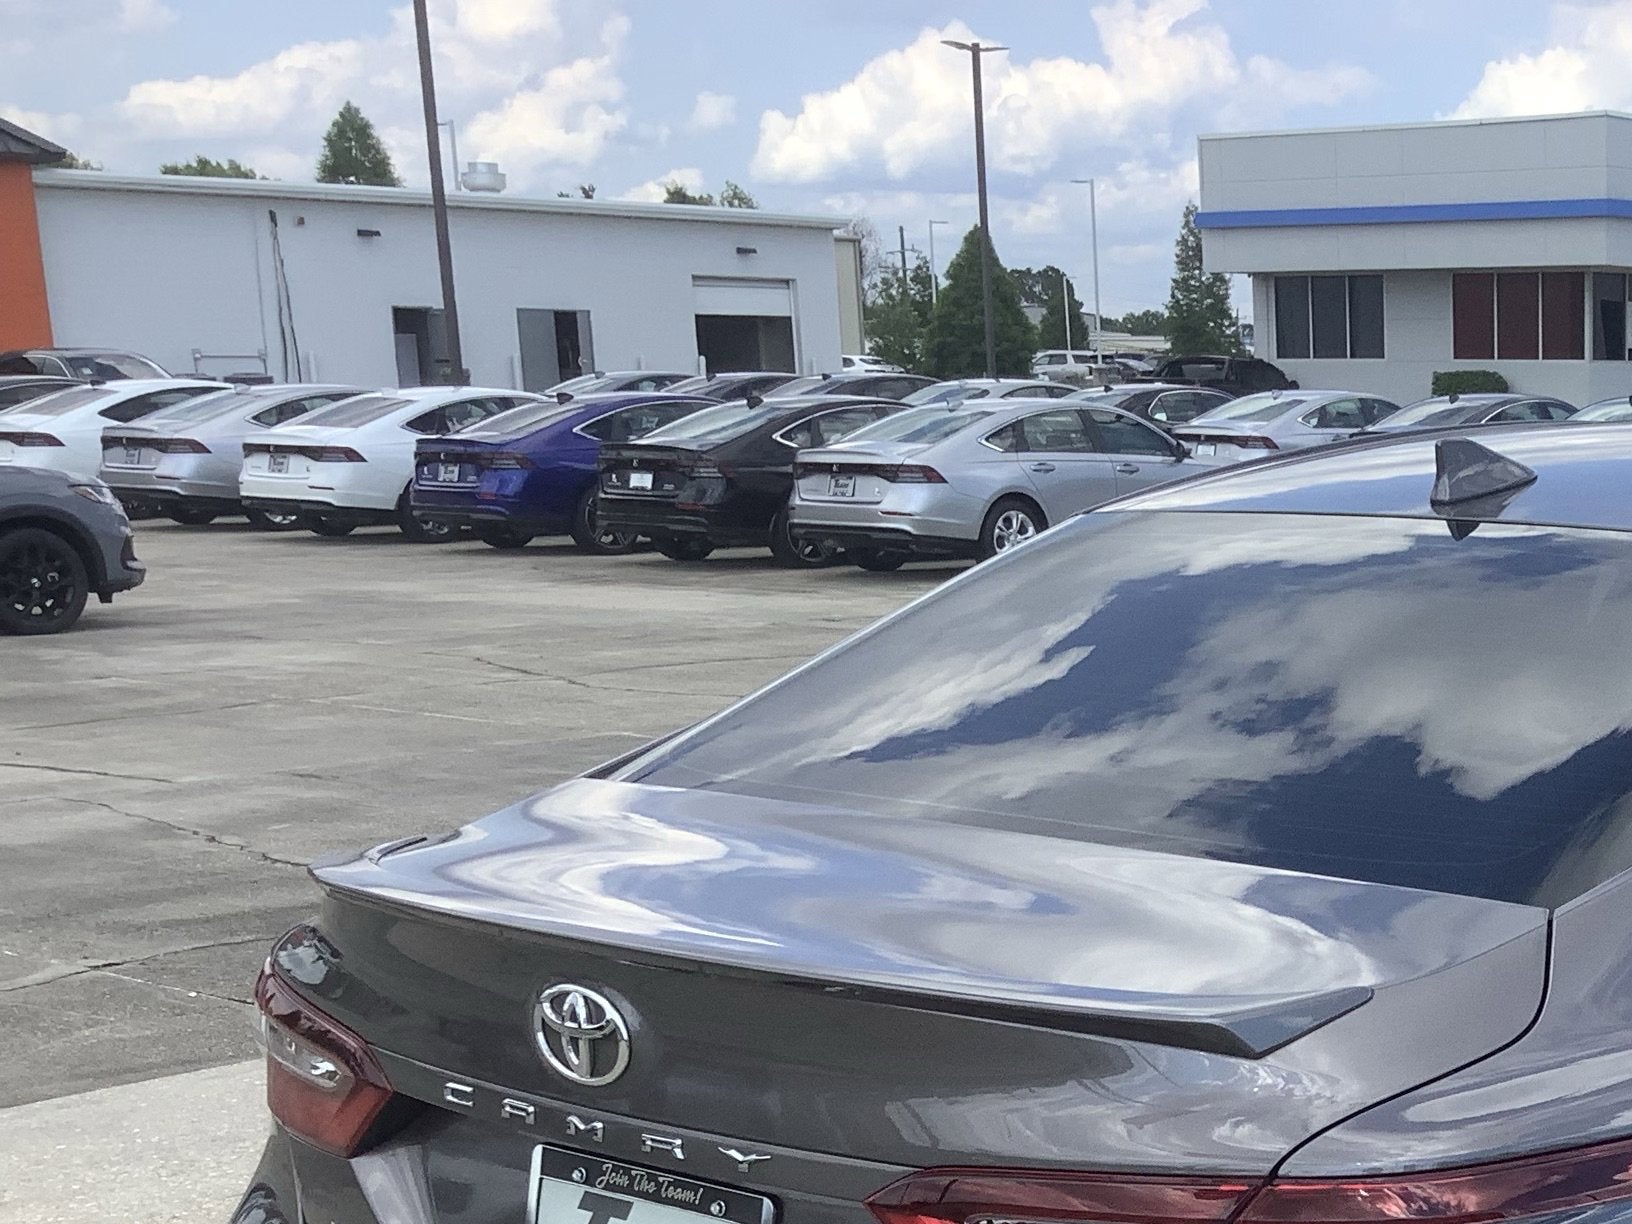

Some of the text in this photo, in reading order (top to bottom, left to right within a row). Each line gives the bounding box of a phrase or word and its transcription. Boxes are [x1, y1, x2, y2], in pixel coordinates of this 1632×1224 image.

[443, 1082, 772, 1173] CAMRY
[595, 1163, 704, 1205] Join The Team!
